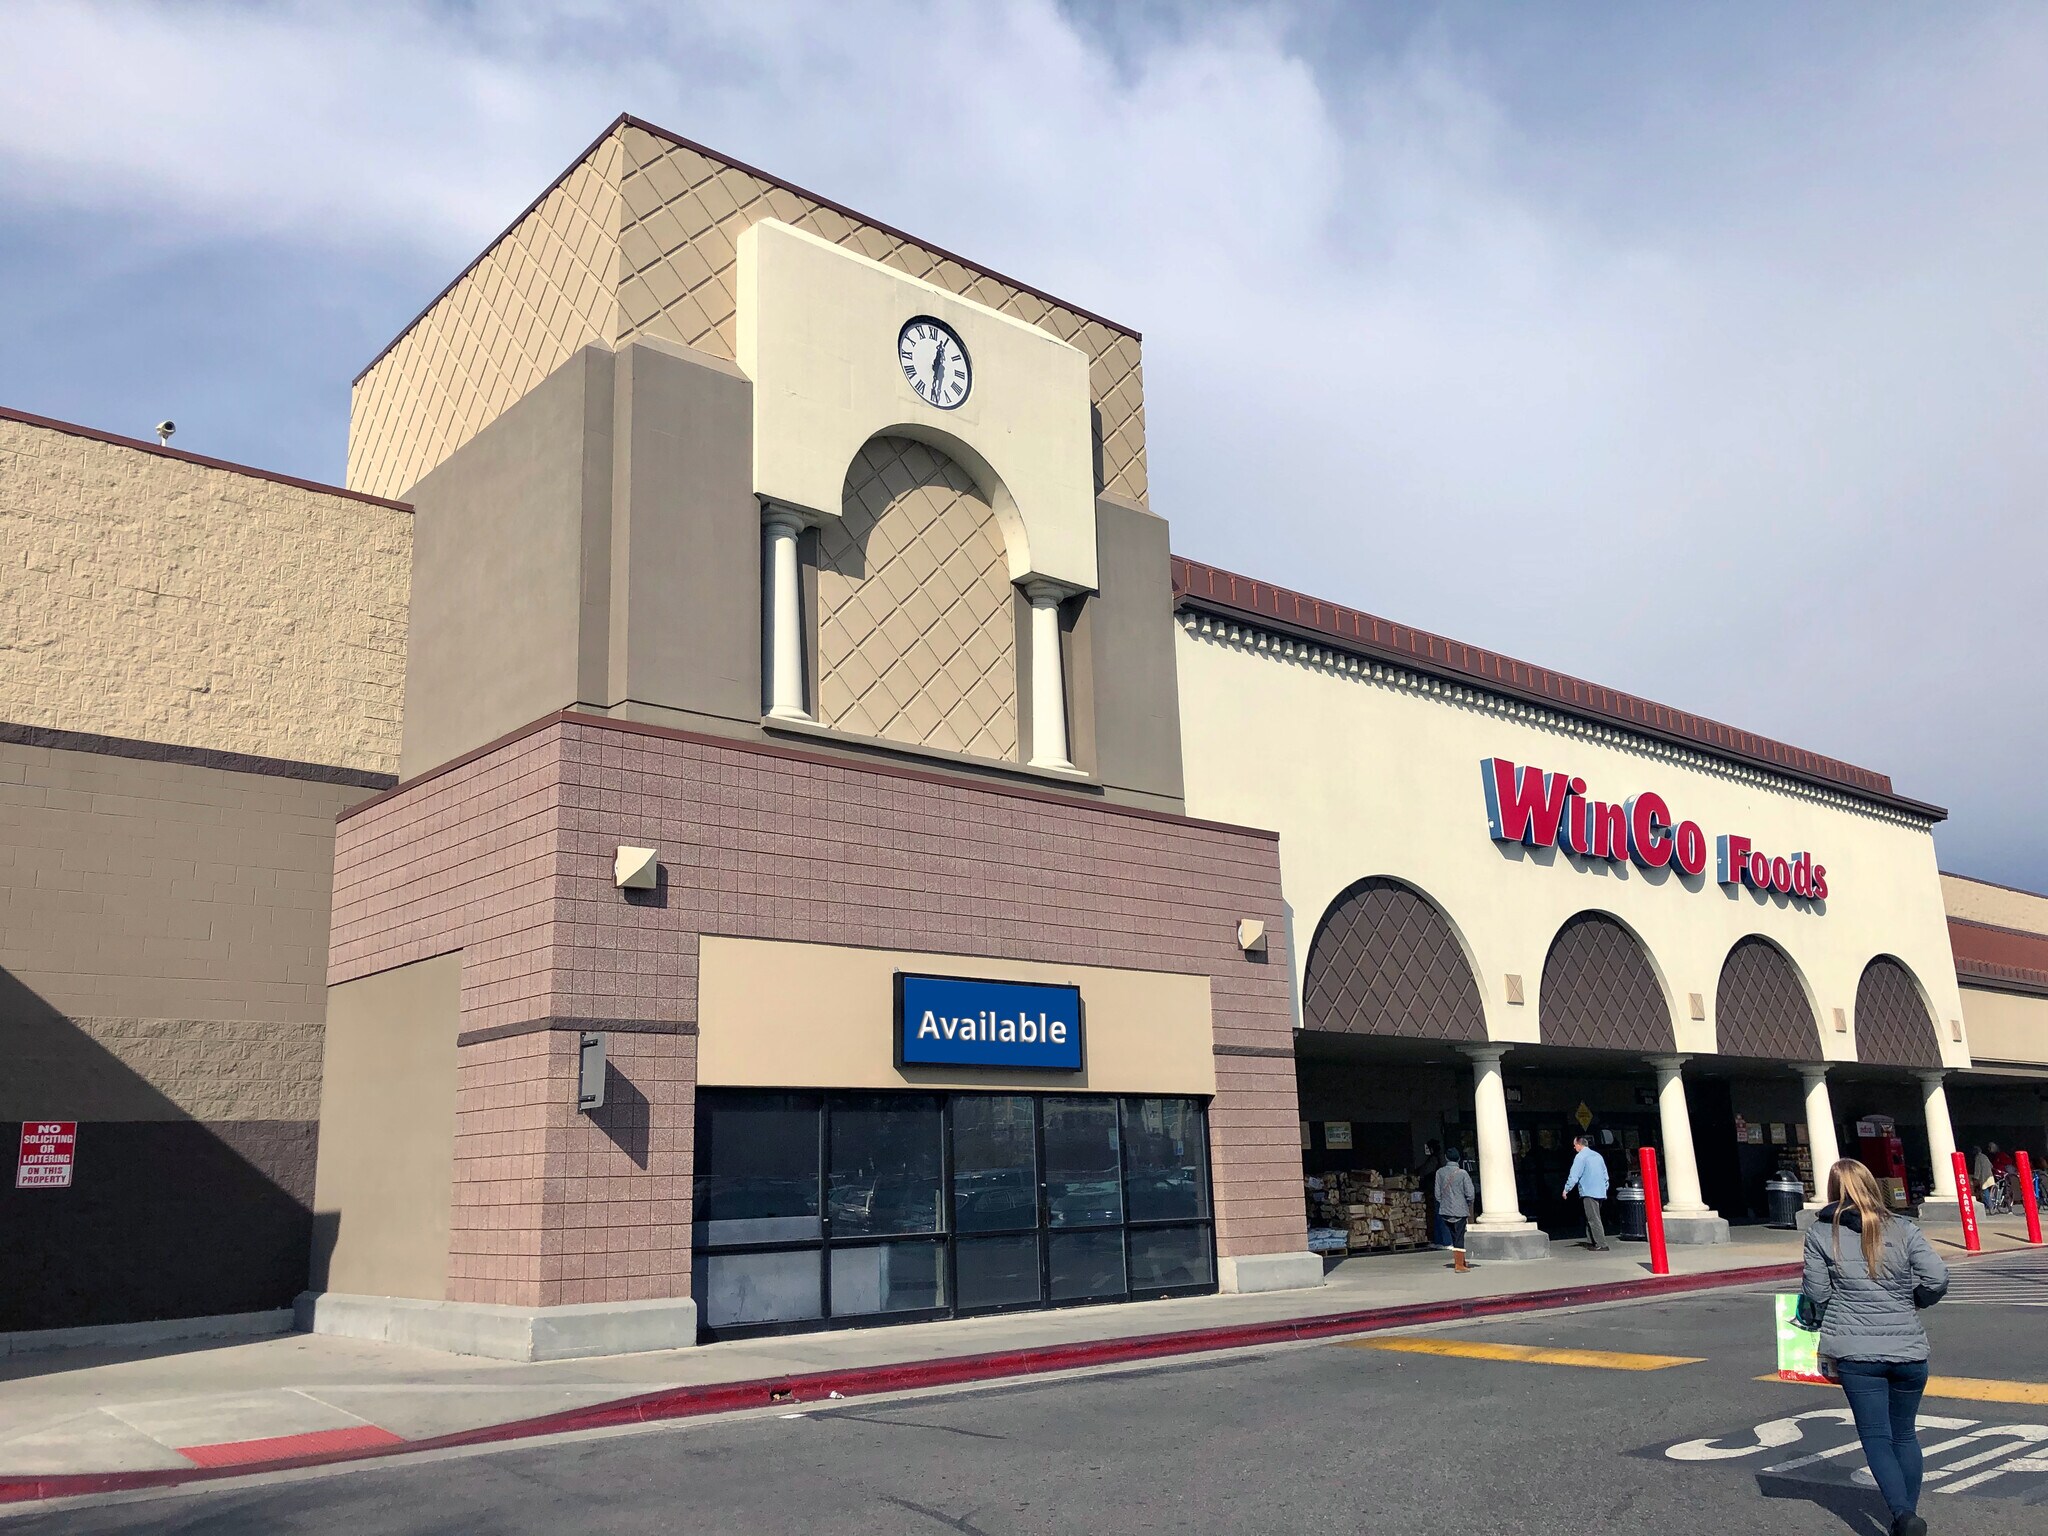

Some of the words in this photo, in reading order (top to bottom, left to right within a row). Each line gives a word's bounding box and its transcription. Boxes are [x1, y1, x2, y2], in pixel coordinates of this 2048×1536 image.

[1480, 757, 1707, 875] WinCo
[1717, 834, 1829, 900] Foods
[917, 1010, 1067, 1044] Available
[38, 1125, 61, 1133] NO
[24, 1134, 73, 1144] SOLICITING
[40, 1144, 55, 1154] OR
[23, 1154, 70, 1164] LOITERING
[22, 1176, 66, 1184] PROPERTY
[1961, 1186, 1974, 1231] ARKNG
